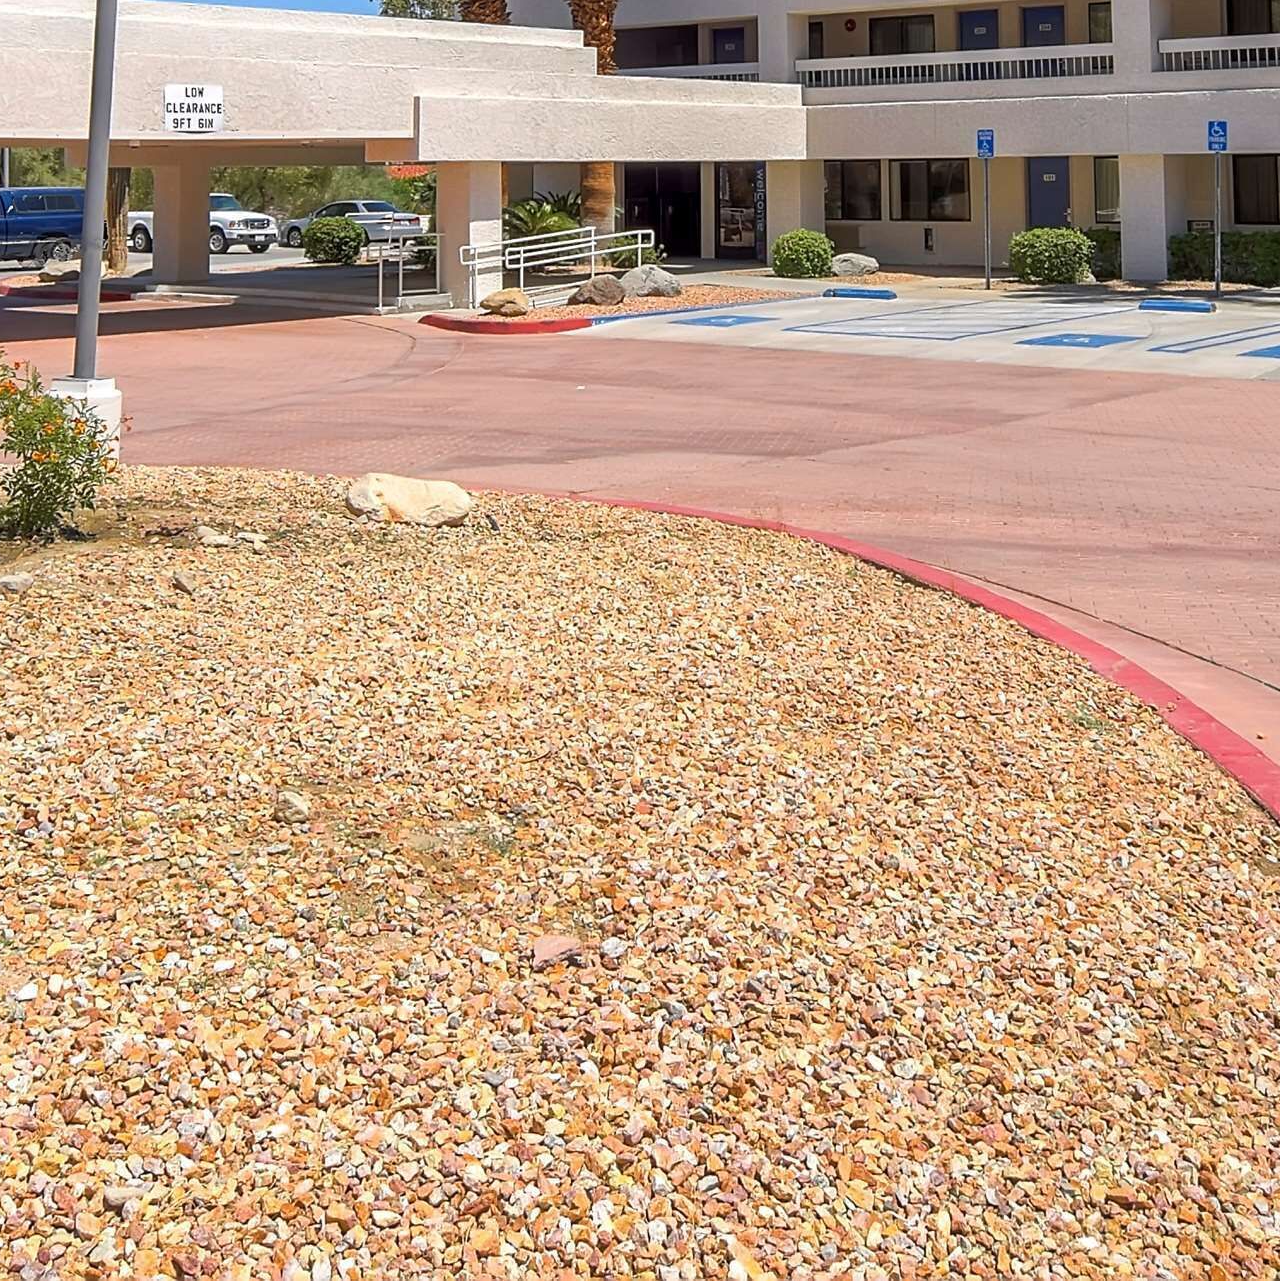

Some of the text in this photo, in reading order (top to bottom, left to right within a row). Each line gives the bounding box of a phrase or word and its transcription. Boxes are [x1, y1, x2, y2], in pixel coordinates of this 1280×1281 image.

[185, 87, 204, 98] LOW
[166, 102, 222, 114] CLEARANCE
[173, 118, 214, 129] 9FT 6IN
[756, 169, 766, 231] welcome
